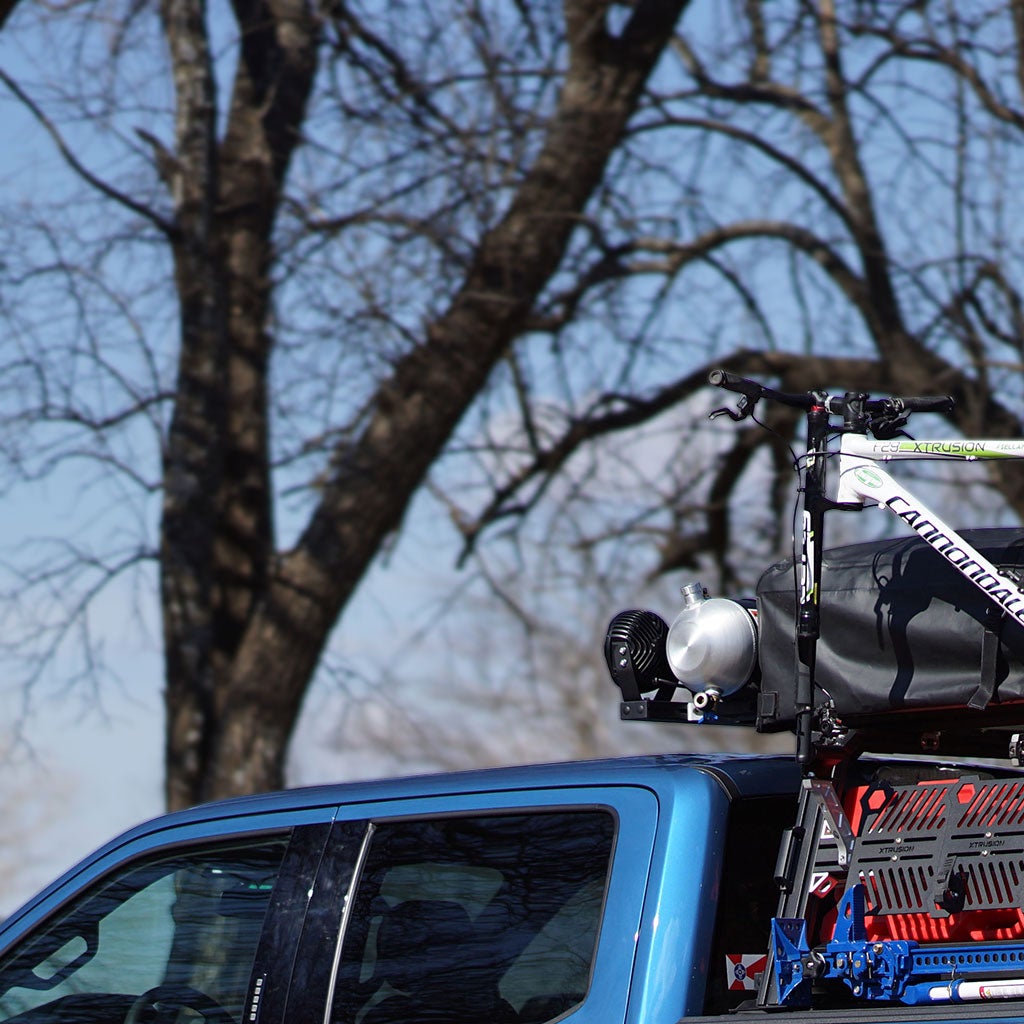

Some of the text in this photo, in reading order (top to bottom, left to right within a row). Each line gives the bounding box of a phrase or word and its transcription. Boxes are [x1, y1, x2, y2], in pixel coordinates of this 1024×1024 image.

[913, 441, 986, 454] XTRUSION
[968, 839, 1006, 849] XTRUSION
[878, 845, 915, 854] XTRUSION
